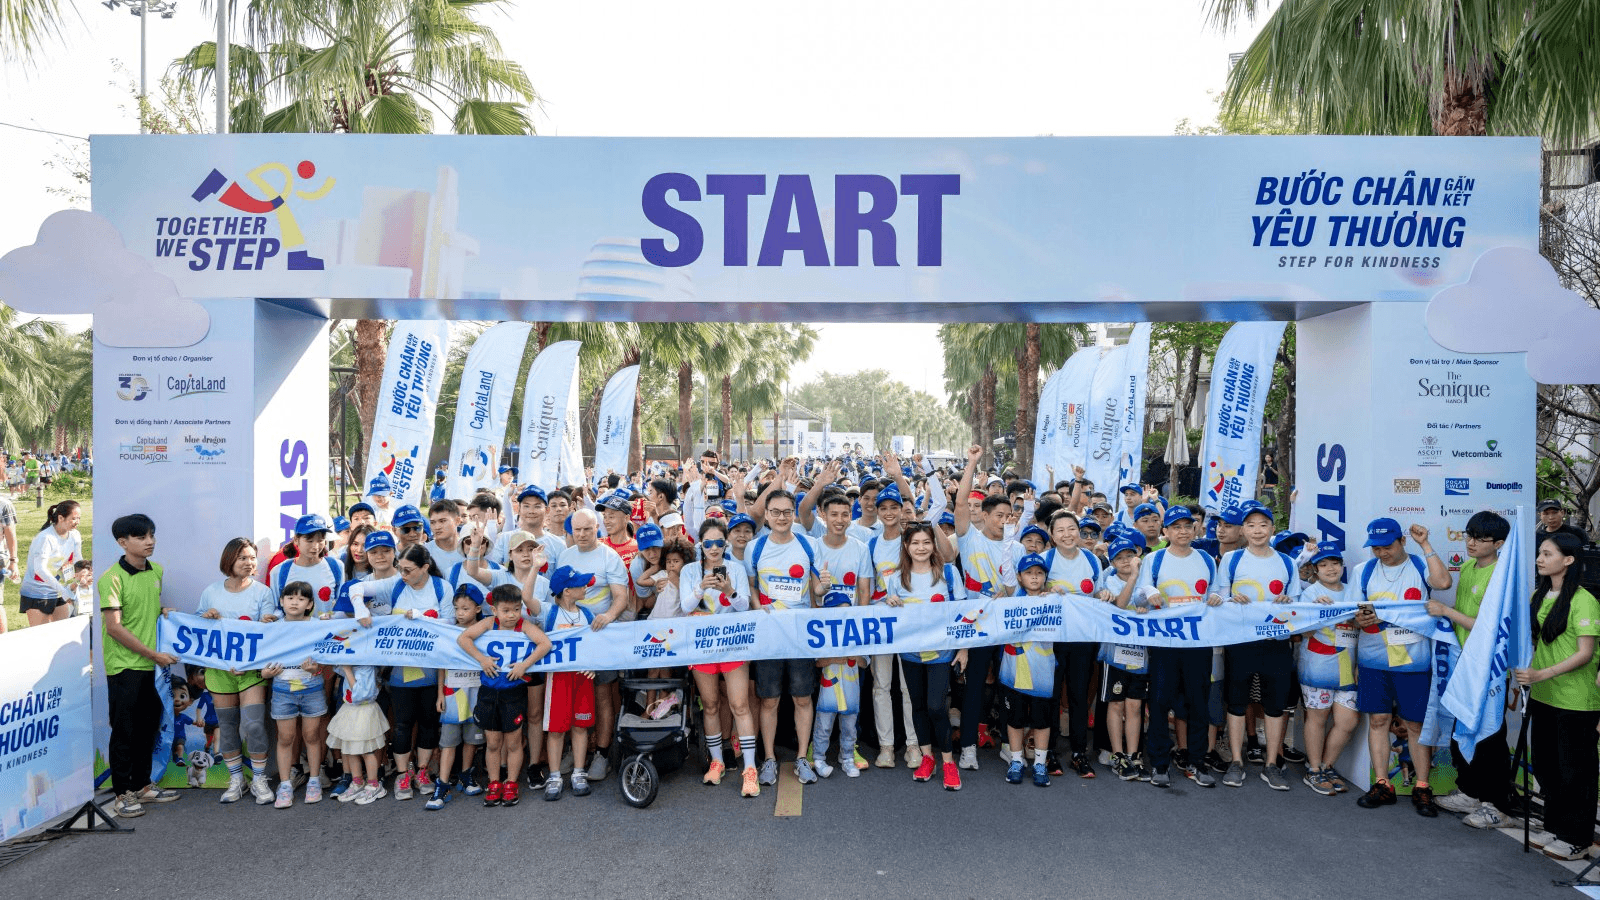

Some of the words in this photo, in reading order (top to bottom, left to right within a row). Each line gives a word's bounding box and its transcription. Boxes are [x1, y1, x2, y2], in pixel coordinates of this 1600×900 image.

[1255, 169, 1344, 206] BƯỚC
[1352, 170, 1441, 206] CHÂN
[1444, 175, 1475, 191] GẮN
[1442, 191, 1472, 206] KẾT
[156, 217, 267, 235] TOGETHER
[640, 172, 961, 267] START
[1252, 208, 1317, 247] YÊU
[1328, 211, 1467, 248] THƯƠNG
[156, 238, 188, 257] WE
[188, 237, 280, 271] STEP
[1278, 256, 1318, 268] STEP
[1324, 256, 1354, 268] FOR
[1361, 256, 1441, 268] KINDNESS
[182, 355, 213, 364] Organiser
[399, 345, 416, 382] CHÂN
[1472, 359, 1500, 367] Sponsor
[167, 373, 226, 394] CapitaLand
[1223, 369, 1239, 402] CHÂN
[1235, 362, 1255, 412] THƯƠNG
[1447, 371, 1462, 380] The
[470, 370, 493, 430] CapitaLand
[1418, 377, 1491, 404] Senique
[405, 393, 421, 421] YÊU
[1218, 403, 1232, 436] BƯỚC
[530, 395, 559, 462] Senique
[1073, 403, 1083, 448] FOUNDATION
[1093, 397, 1119, 462] Senique
[1230, 413, 1246, 440] YÊU
[136, 436, 168, 445] CapitaLand
[184, 435, 201, 444] blue
[201, 436, 226, 447] dragon
[1452, 449, 1503, 458] Vietcombank
[119, 453, 168, 462] FOUNDATION
[400, 457, 415, 490] STEP
[1486, 482, 1523, 490] Dunlopillo
[280, 439, 308, 548] STA
[1228, 476, 1242, 507] STEP
[1317, 443, 1346, 552] STA
[1004, 605, 1028, 618] BƯỚC
[1030, 604, 1054, 616] CHÂN
[1004, 618, 1022, 630] YÊU
[1026, 615, 1062, 628] THƯƠNG
[377, 625, 404, 637] BƯỚC
[405, 627, 429, 639] CHÂN
[695, 626, 721, 638] BƯỚC
[722, 622, 747, 636] CHÂN
[806, 617, 897, 648] START
[955, 629, 977, 639] STEP
[1111, 613, 1202, 640] START
[173, 625, 264, 662] START
[319, 644, 345, 654] STEP
[374, 637, 394, 649] YÊU
[396, 639, 435, 652] THƯƠNG
[642, 647, 666, 658] STEP
[695, 637, 713, 649] YÊU
[716, 633, 755, 647] THƯƠNG
[0, 691, 47, 726] CHÂN
[0, 714, 60, 757] HƯƠNG
[6, 746, 48, 770] KINDNESS
